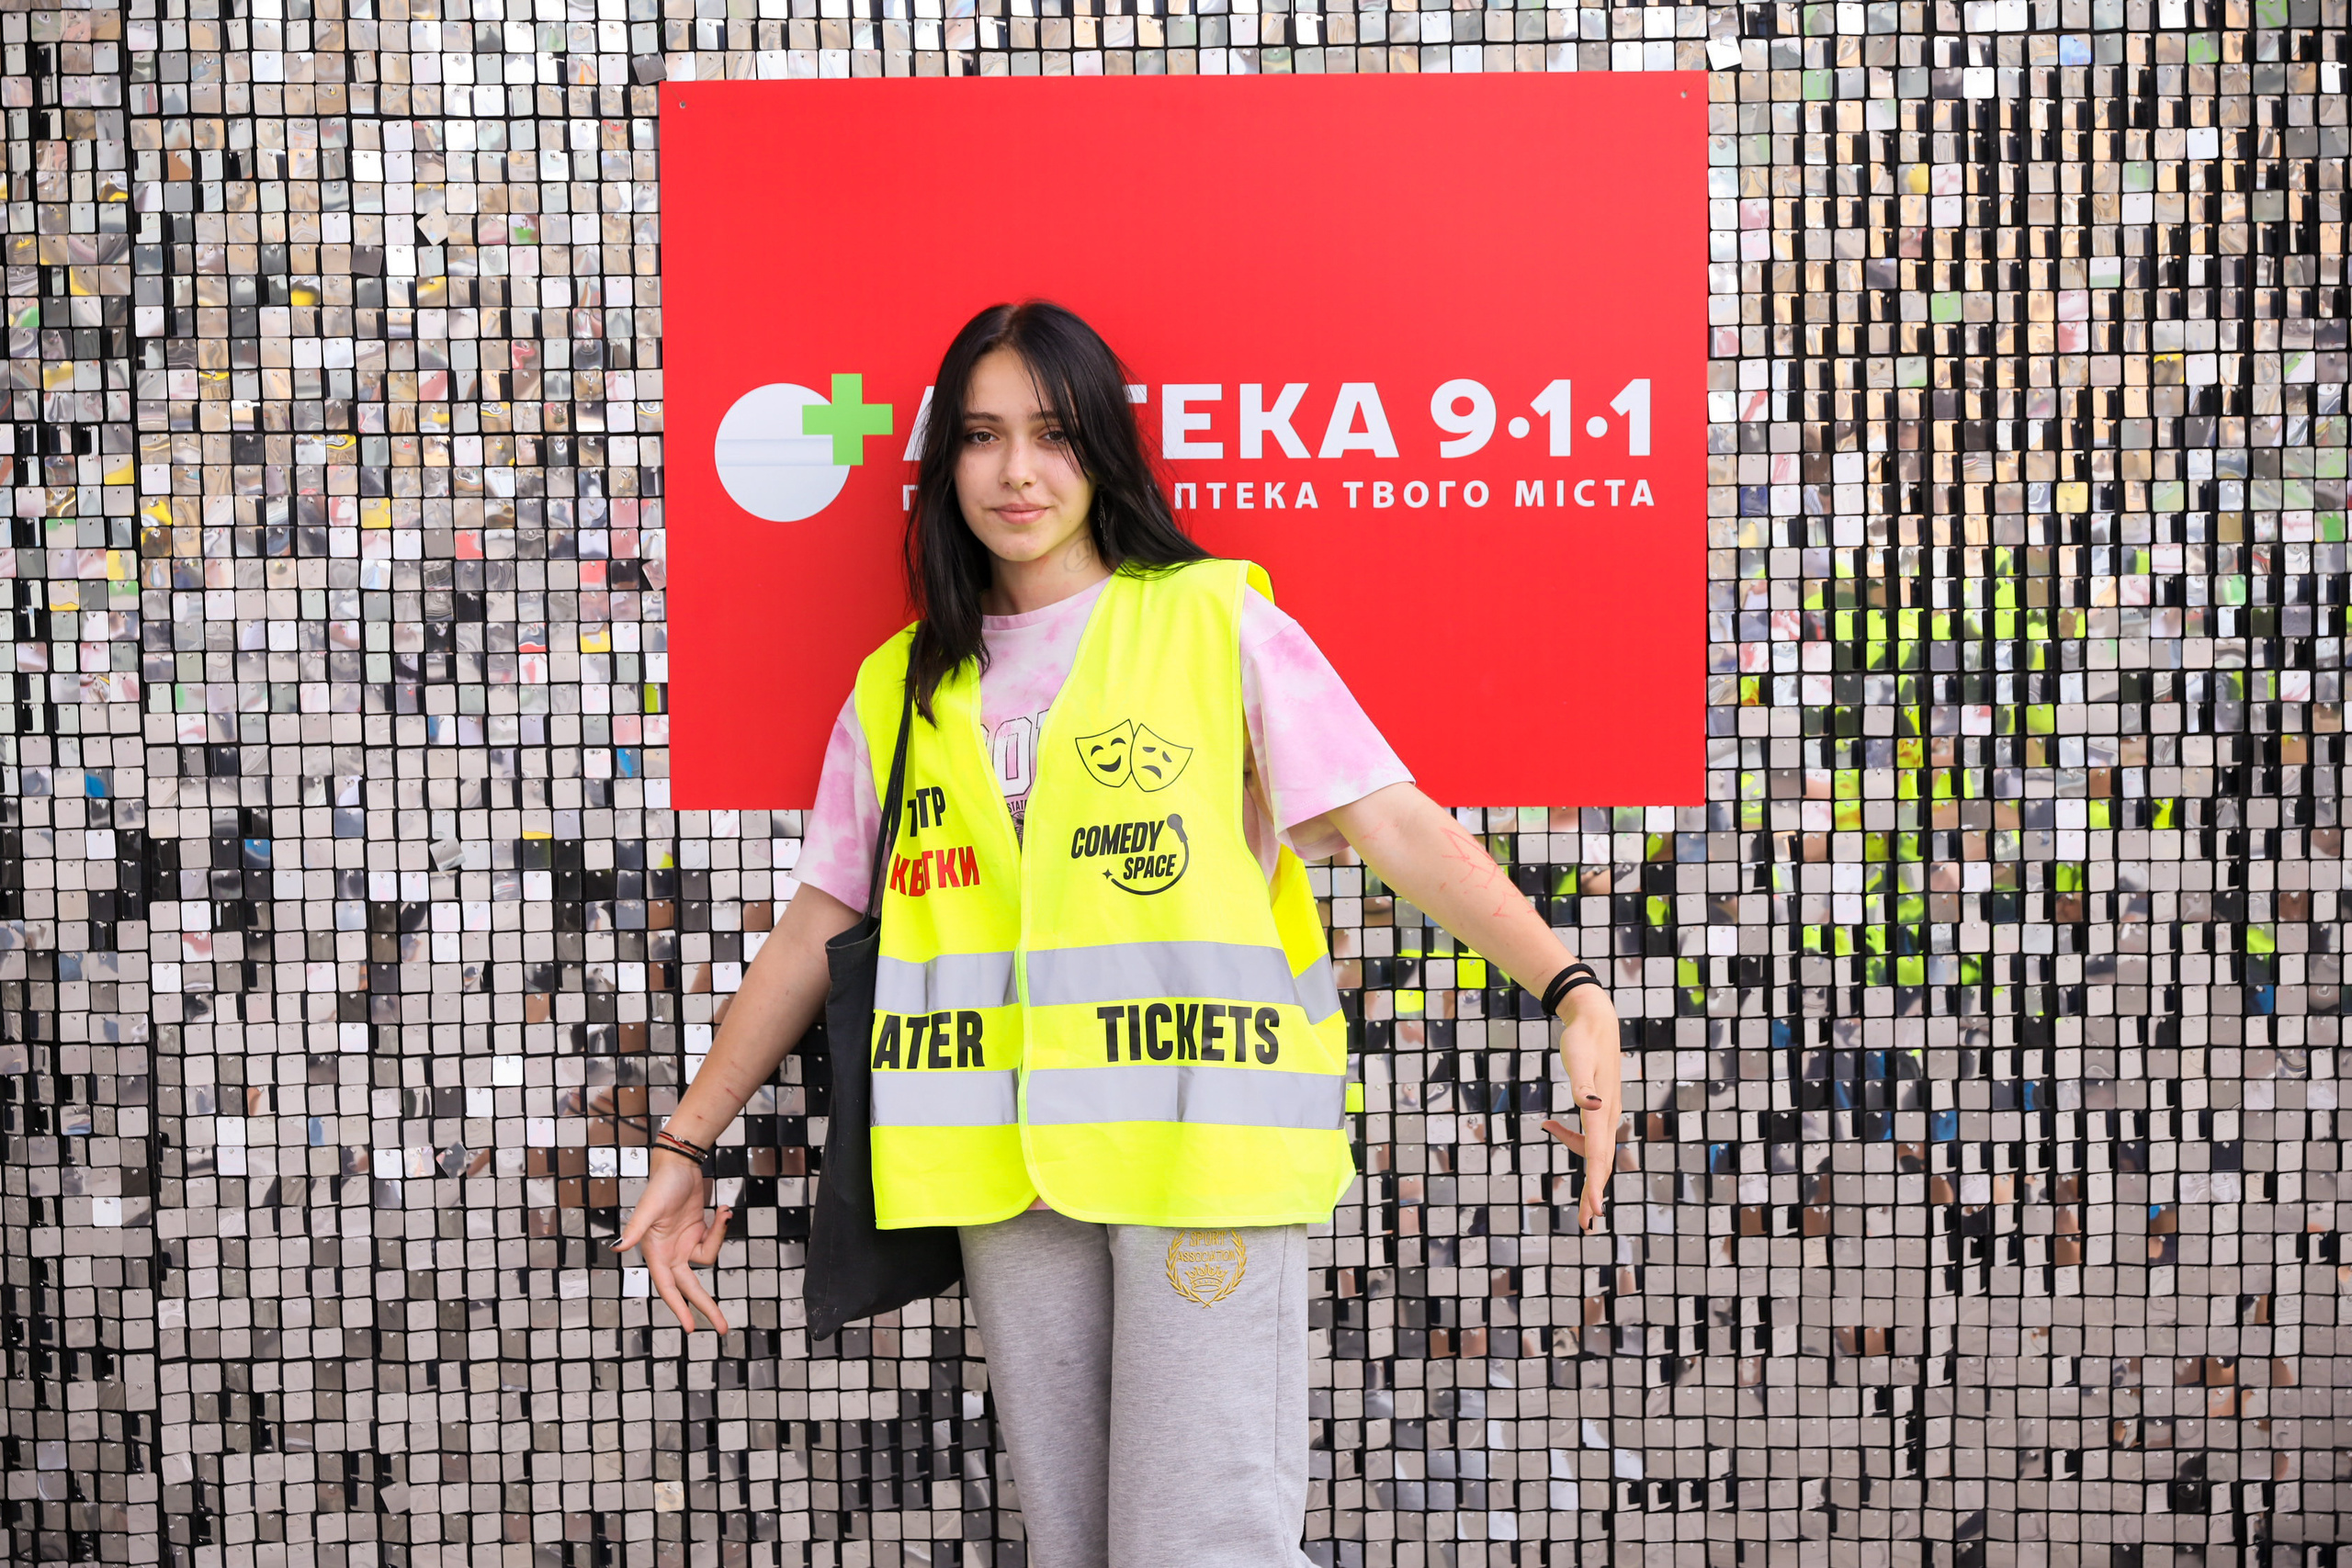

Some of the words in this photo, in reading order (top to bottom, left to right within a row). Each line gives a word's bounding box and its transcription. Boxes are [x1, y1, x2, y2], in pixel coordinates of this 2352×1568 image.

[1174, 481, 1319, 510] ПТЕКА
[1342, 479, 1491, 509] ТВОГО
[1514, 479, 1656, 508] МІСТА
[1070, 819, 1166, 860] COMEDY
[1123, 853, 1178, 881] SPACE
[872, 1010, 986, 1070] ATER
[1097, 1002, 1281, 1066] TICKETS
[1189, 1230, 1227, 1247] SPORT
[1177, 1249, 1236, 1262] ASSOCIATION
